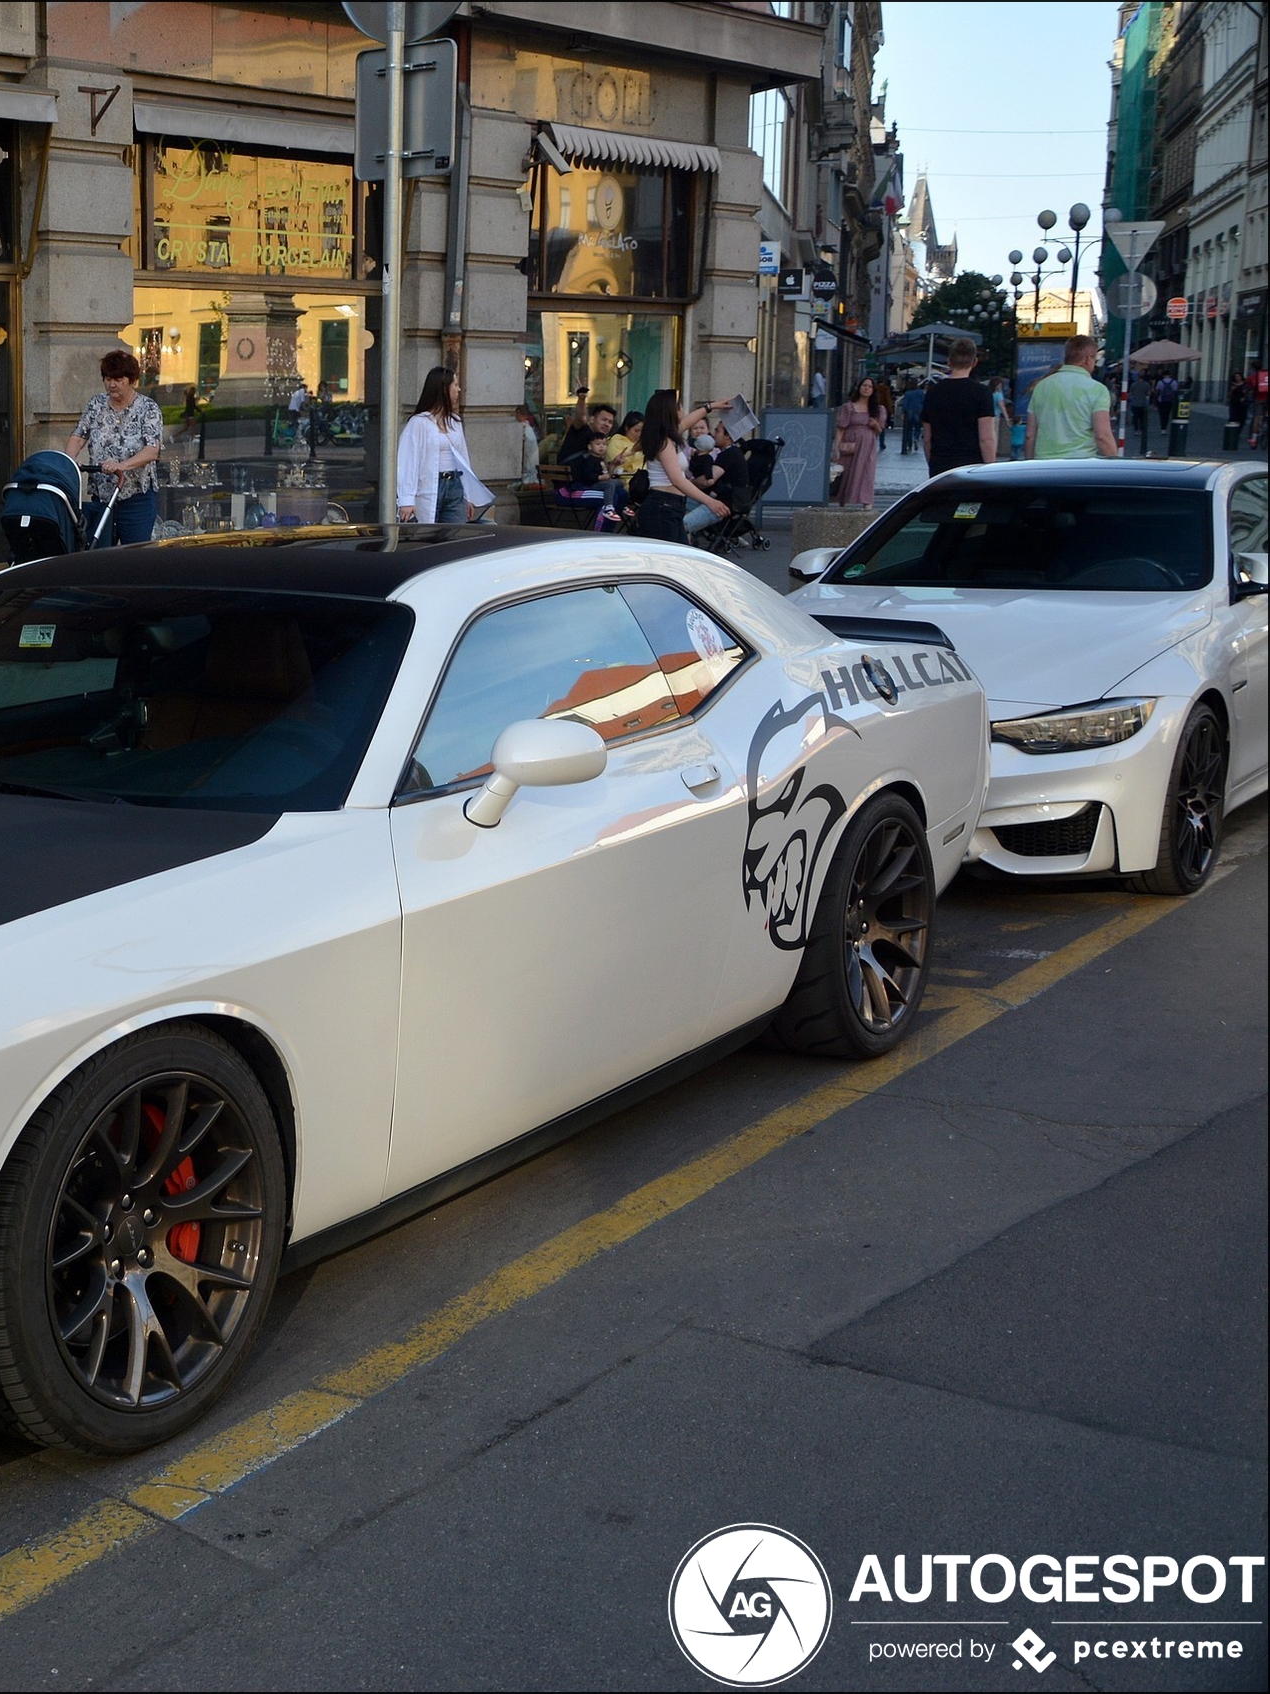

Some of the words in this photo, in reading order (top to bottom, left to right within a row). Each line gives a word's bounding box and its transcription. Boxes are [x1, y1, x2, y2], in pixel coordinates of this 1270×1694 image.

[264, 175, 349, 204] BOHEMIA
[158, 238, 238, 264] CRYSTAL
[251, 244, 348, 269] PORCELAIN
